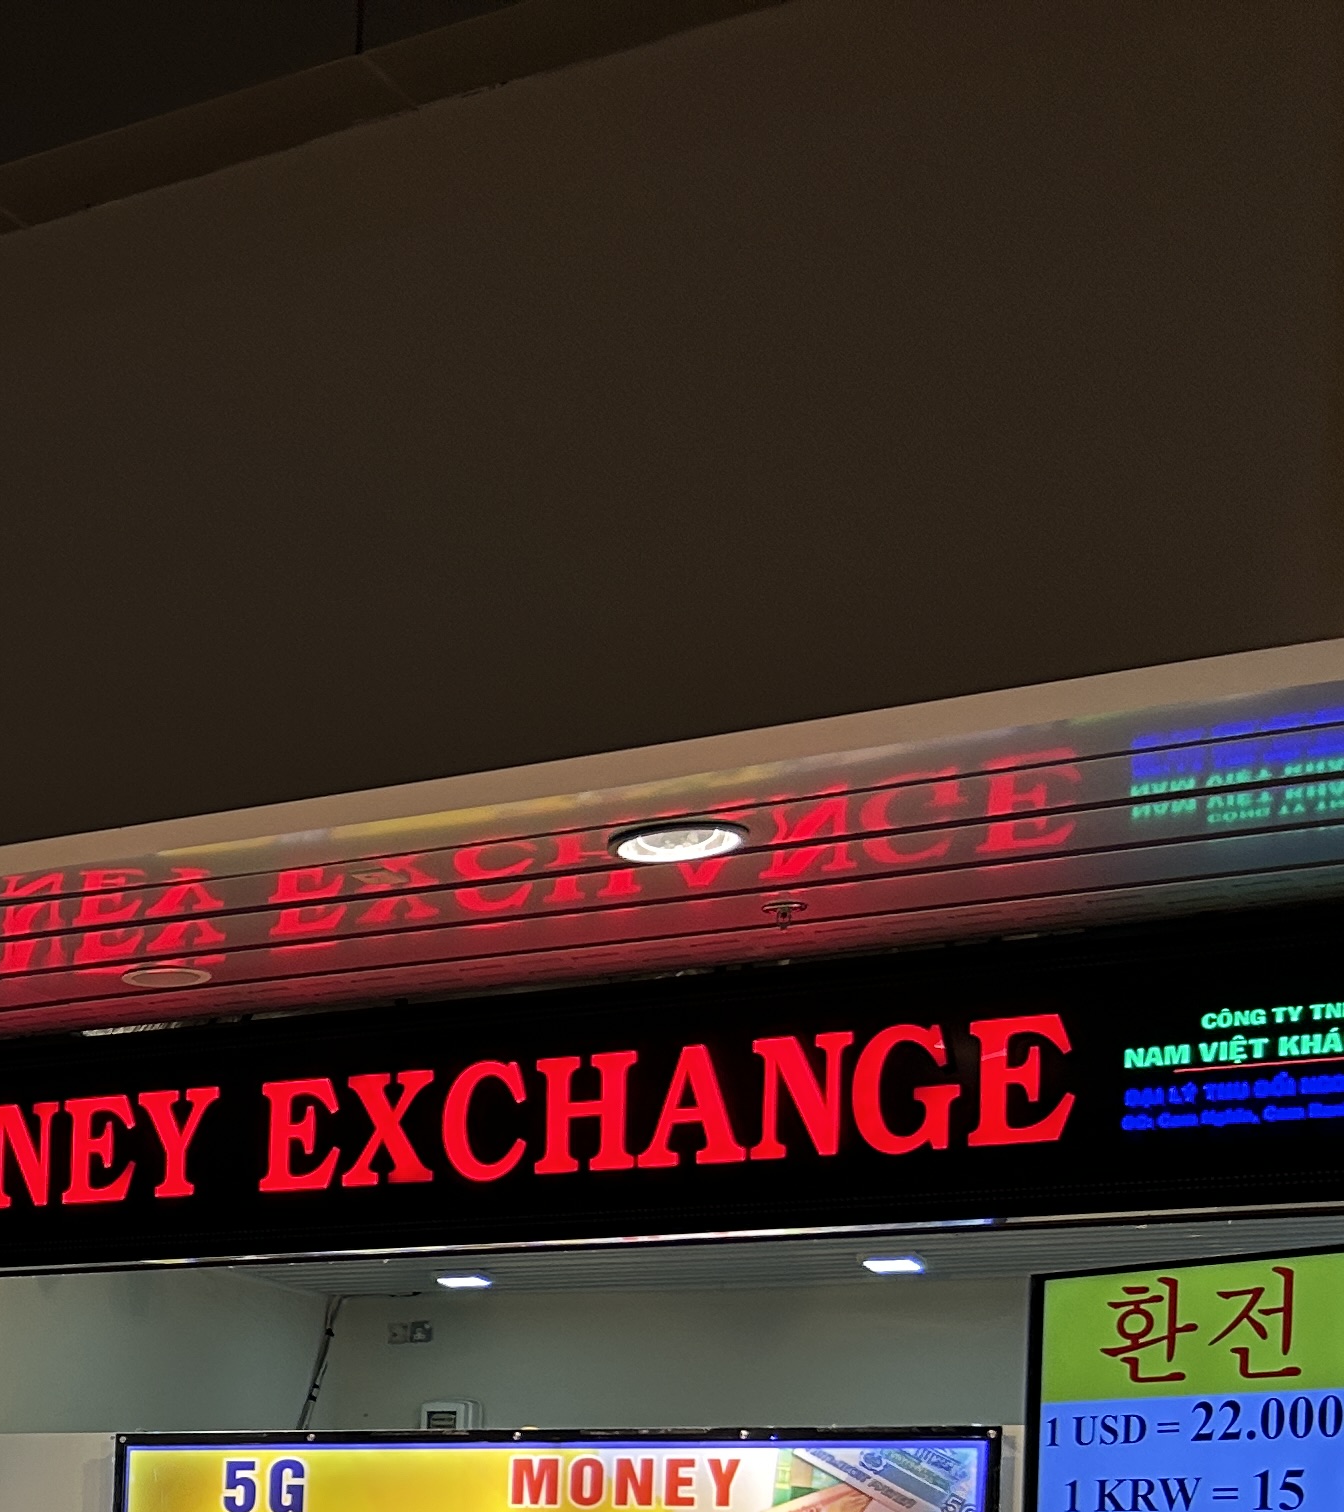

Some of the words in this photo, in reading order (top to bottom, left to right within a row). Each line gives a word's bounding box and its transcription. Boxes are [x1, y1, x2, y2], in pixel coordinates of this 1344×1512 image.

[1201, 1008, 1267, 1030] CÔNG
[1271, 1006, 1303, 1023] TY
[1123, 1044, 1190, 1069] NAM
[1198, 1035, 1269, 1064] VIỆT
[258, 1013, 1076, 1193] EXCHANGE
[1100, 1266, 1302, 1384] 환전
[1046, 1417, 1060, 1447] 1
[1073, 1414, 1147, 1446] USD
[1190, 1395, 1343, 1442] 22.000
[510, 1457, 742, 1508] MONEY
[1065, 1480, 1080, 1512] 1
[1094, 1477, 1202, 1512] KRW
[1252, 1469, 1306, 1512] 15
